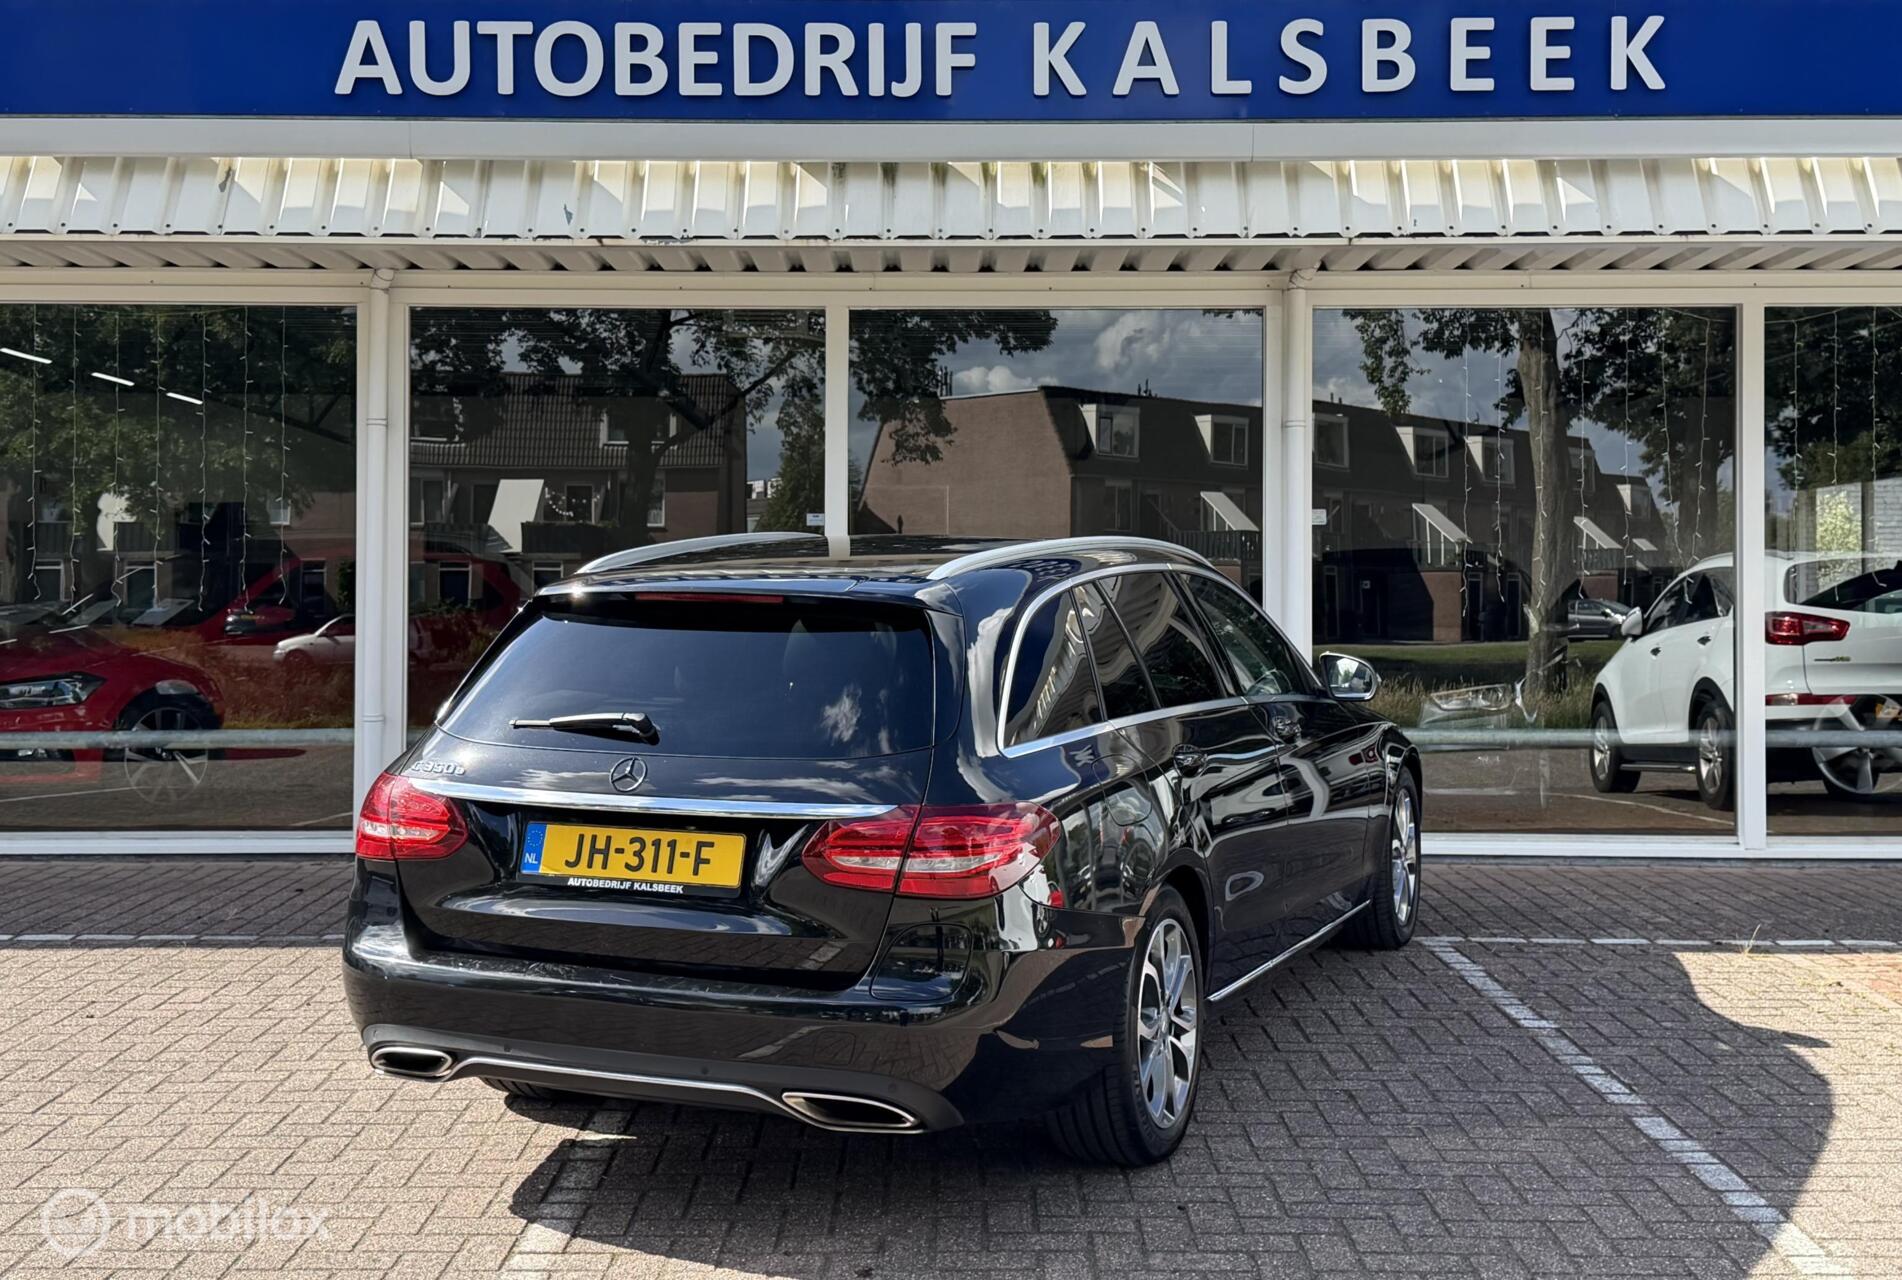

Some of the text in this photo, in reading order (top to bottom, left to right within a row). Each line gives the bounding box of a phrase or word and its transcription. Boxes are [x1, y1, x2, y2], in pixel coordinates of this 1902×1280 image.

[334, 15, 1666, 97] AUTOBEDRIJF KALSBEEK
[524, 853, 539, 864] NL
[564, 833, 715, 876] JH-311-F
[567, 877, 684, 894] AUTOBEDRIJF KALSBEEK
